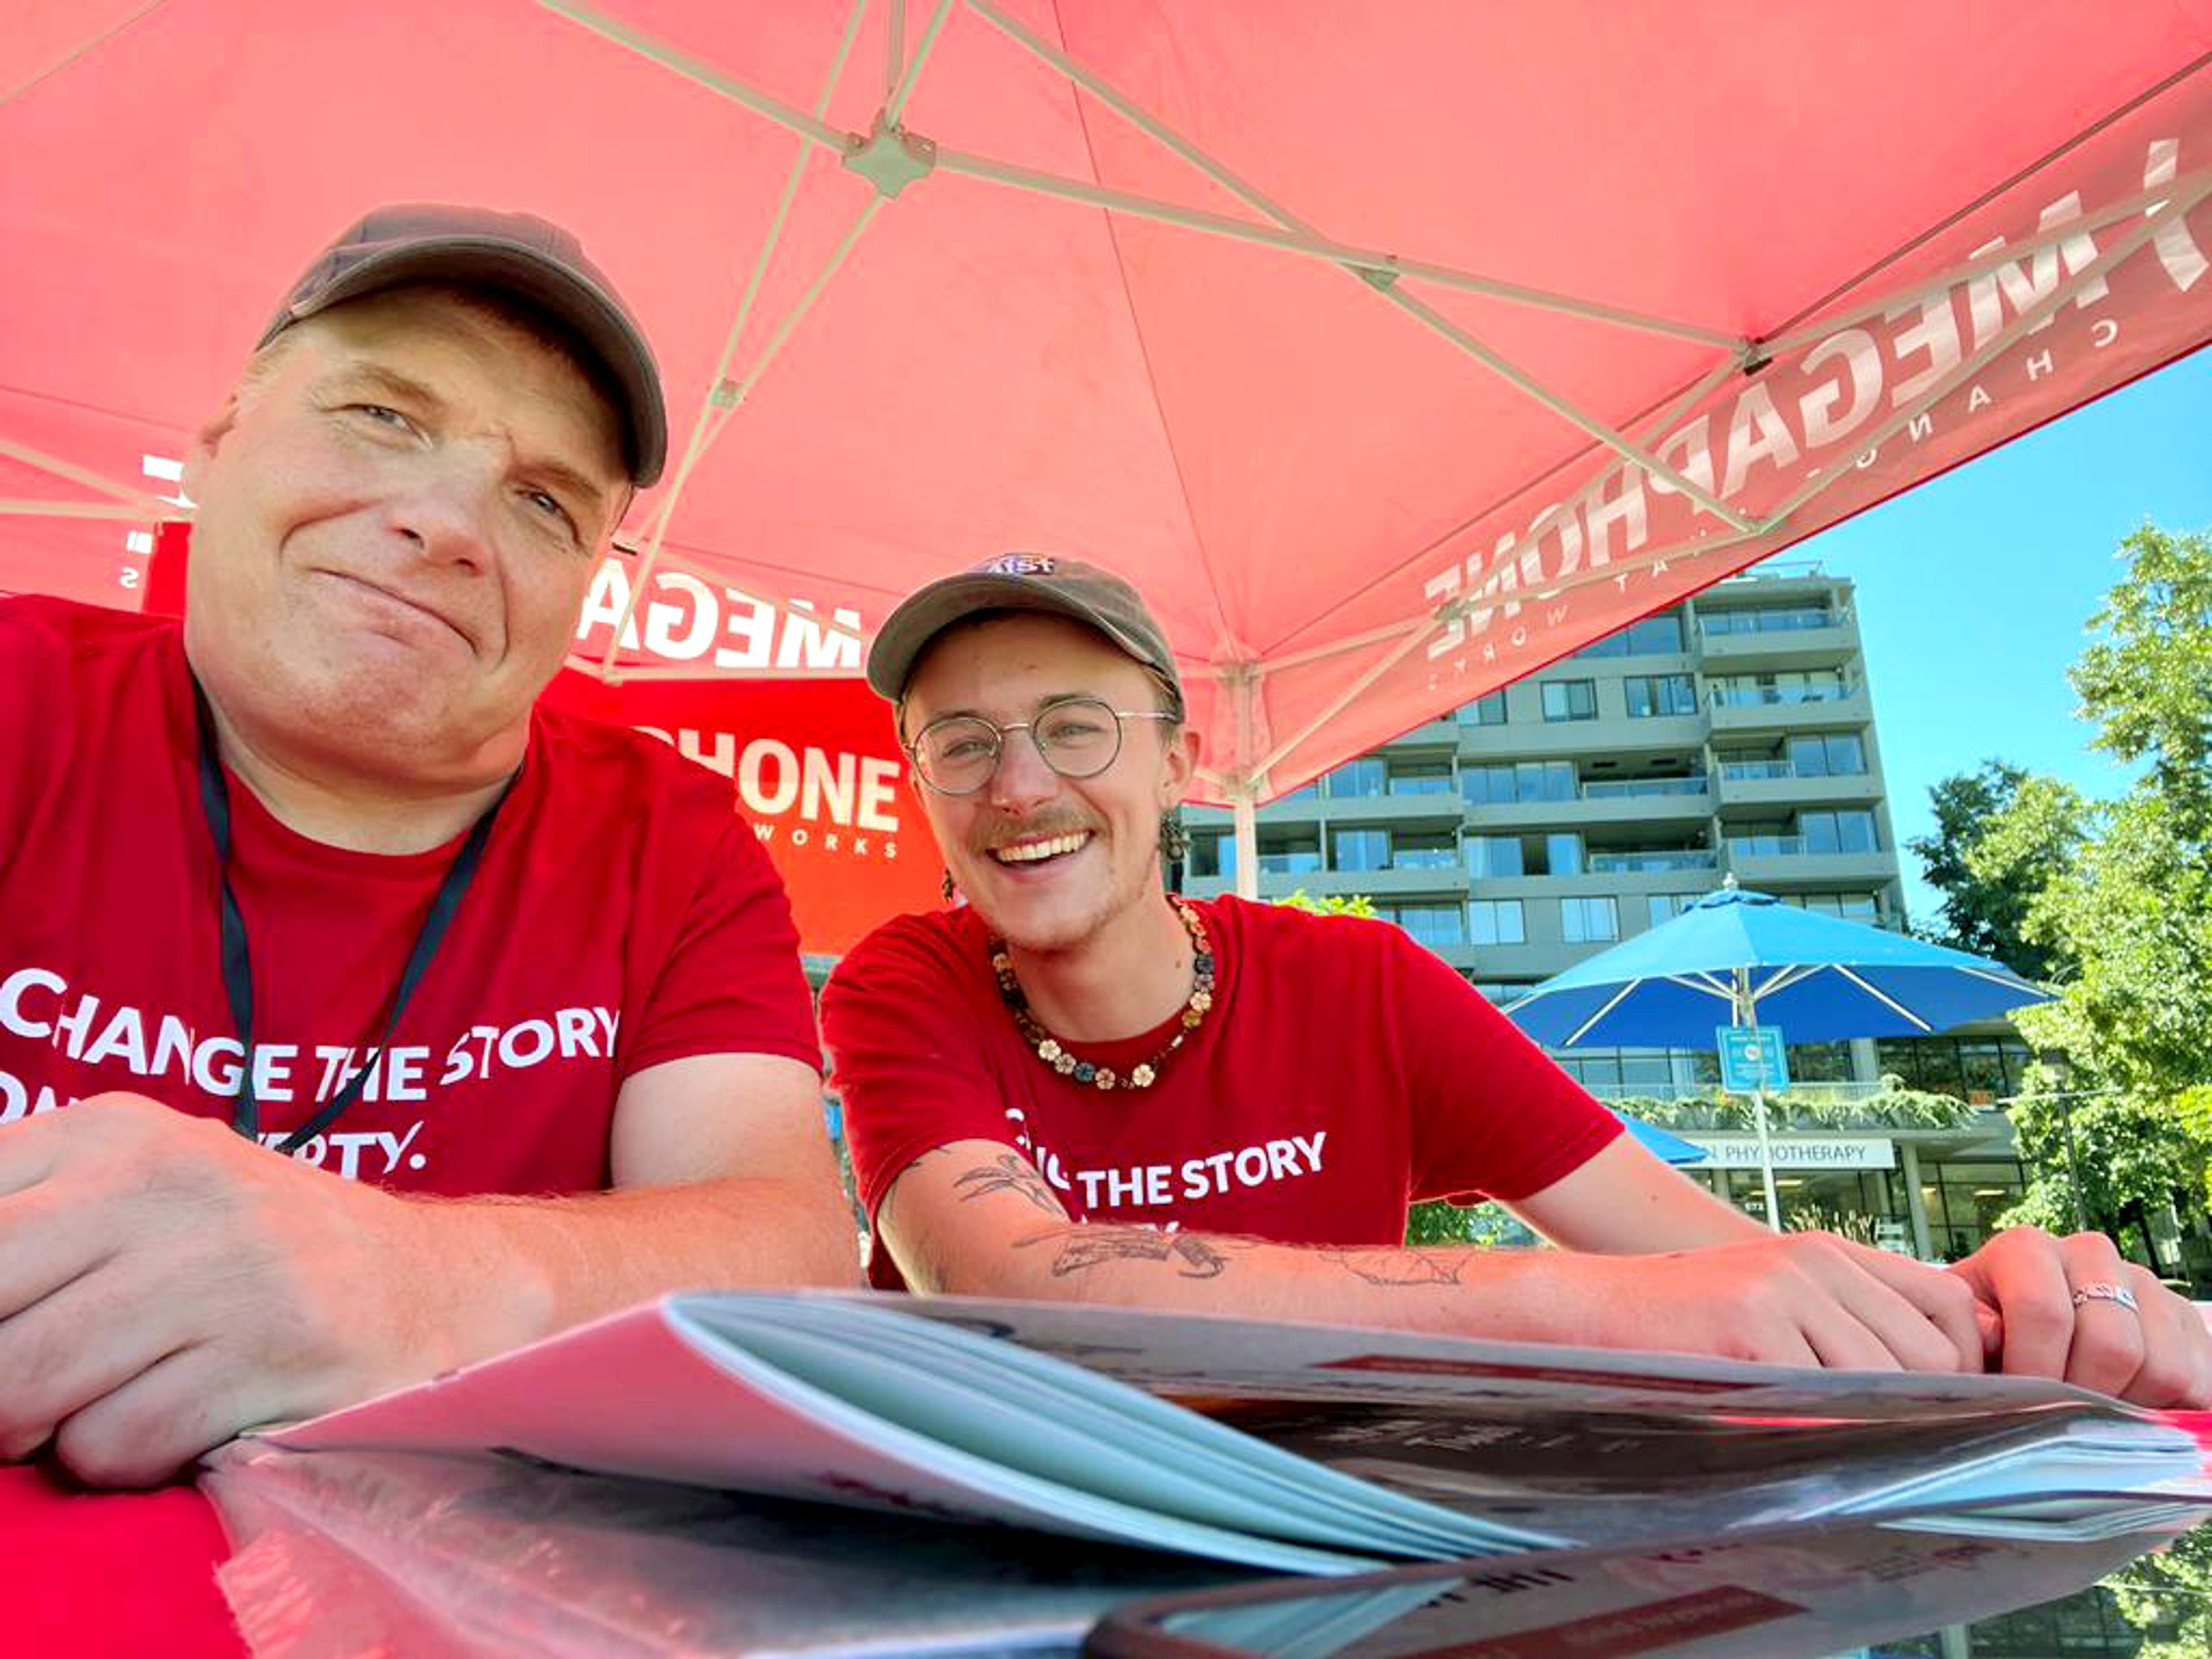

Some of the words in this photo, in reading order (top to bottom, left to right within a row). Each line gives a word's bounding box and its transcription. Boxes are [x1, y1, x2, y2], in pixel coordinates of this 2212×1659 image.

[753, 824, 896, 859] WORKS
[0, 968, 293, 1101] CHANGE
[315, 1046, 430, 1103] THE
[440, 1006, 620, 1085] STORY
[1075, 1165, 1174, 1209] THE
[1181, 1132, 1326, 1199] STORY
[1725, 1145, 1866, 1160] PHYIOTHERAPY
